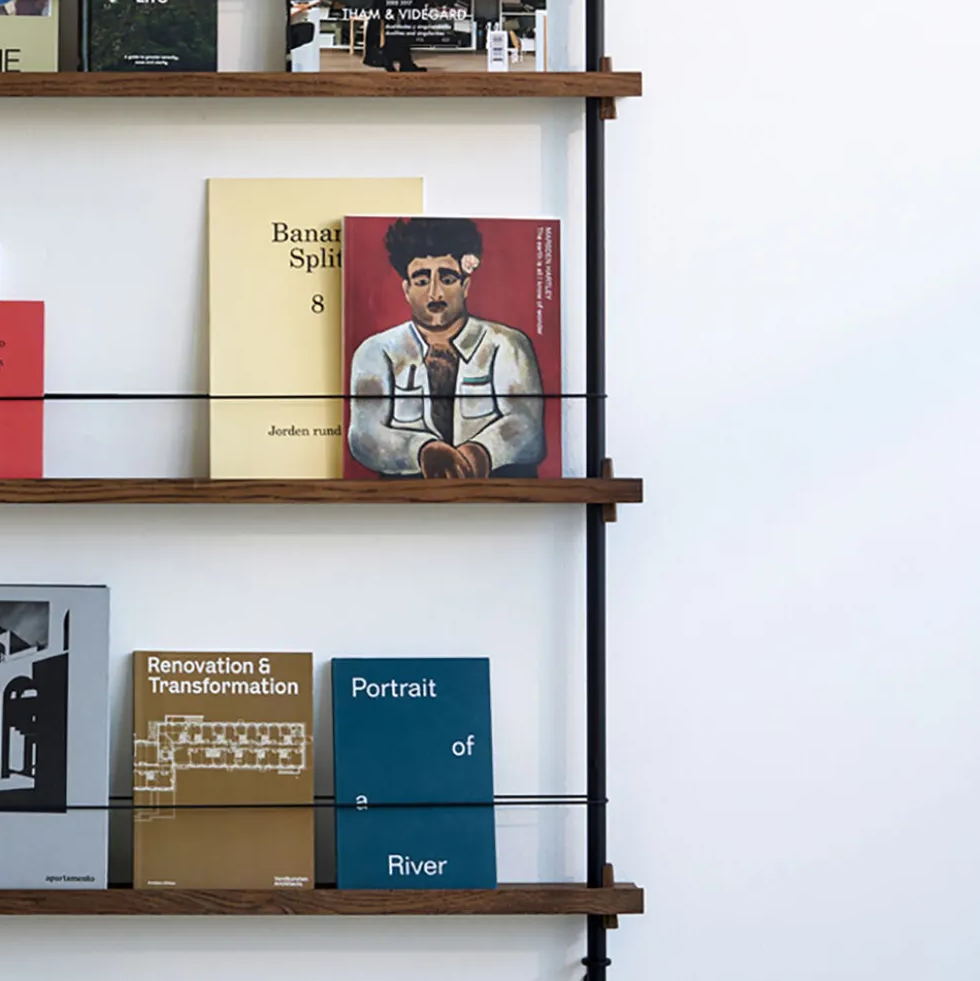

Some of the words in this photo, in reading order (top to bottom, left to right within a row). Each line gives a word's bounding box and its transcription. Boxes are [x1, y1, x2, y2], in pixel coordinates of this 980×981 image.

[342, 8, 380, 20] THAM
[384, 8, 395, 20] &
[290, 248, 342, 273] Split
[311, 294, 325, 314] 8
[268, 425, 310, 436] Jorden
[313, 424, 342, 436] rund
[148, 656, 254, 674] Renovation
[258, 658, 270, 674] &
[148, 676, 299, 695] Transformation
[352, 677, 437, 698] Portrait
[452, 734, 475, 756] of
[356, 794, 368, 810] a
[388, 854, 448, 876] River
[44, 874, 96, 883] apartamento
